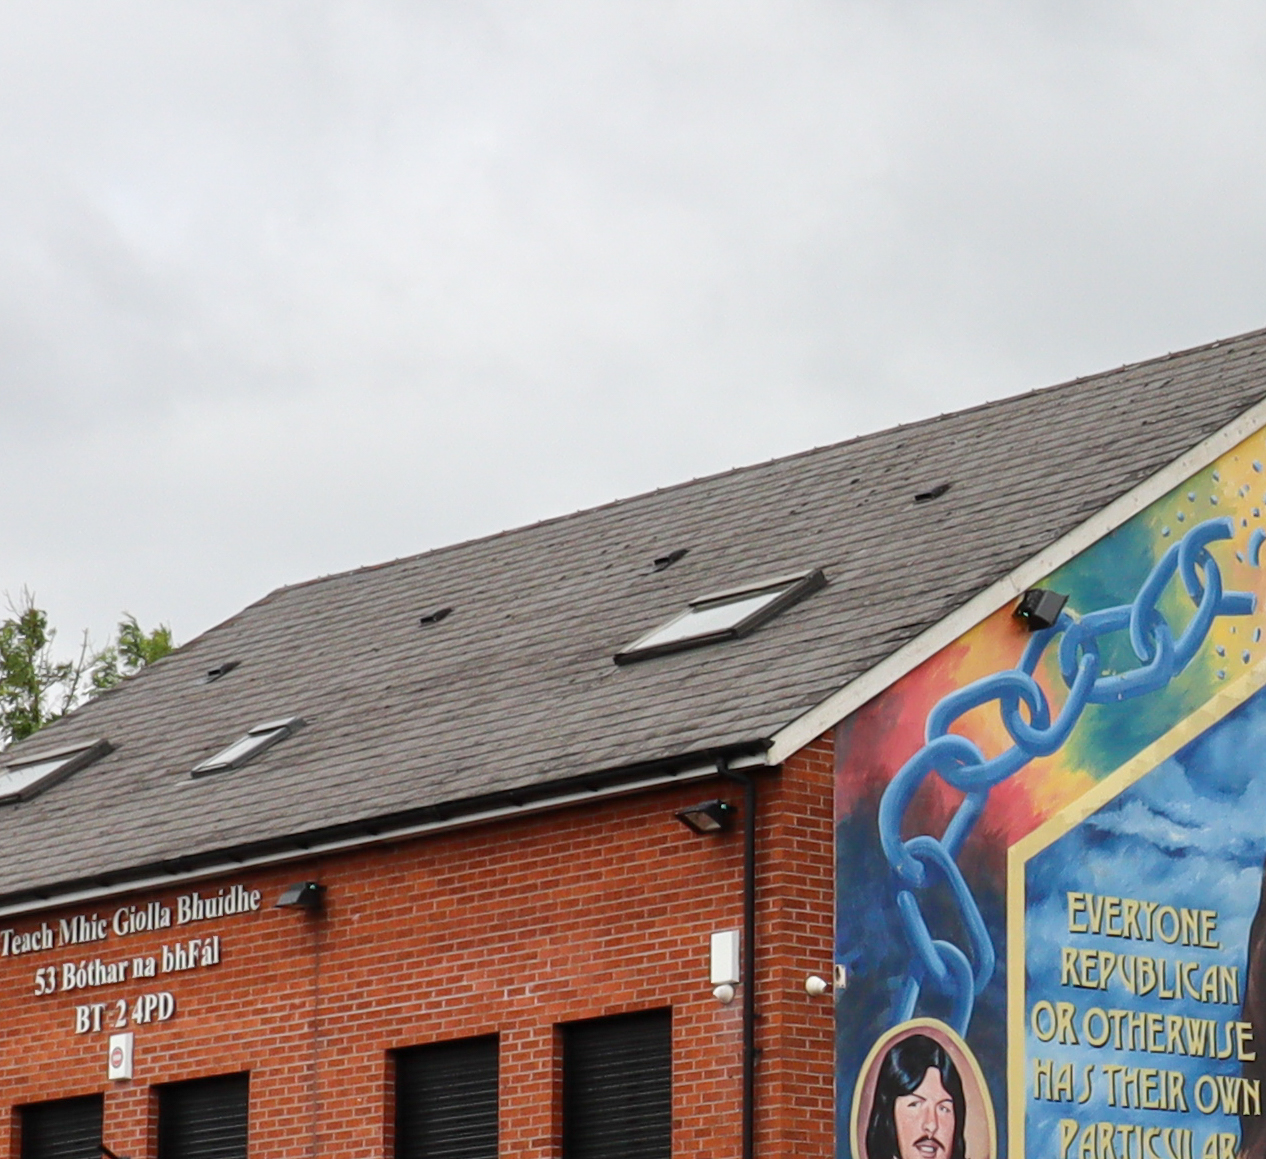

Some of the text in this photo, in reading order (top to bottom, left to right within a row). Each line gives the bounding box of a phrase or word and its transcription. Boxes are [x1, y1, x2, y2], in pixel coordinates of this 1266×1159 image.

[0, 884, 261, 957] Teach Mhic Giolla Bhuidhe
[34, 936, 221, 996] 53 Bóthar na bhFál
[1060, 946, 1241, 1005] REPUBLICAN
[75, 991, 175, 1035] BT 2 4PD
[1031, 1000, 1257, 1061] OR OTHERWISE
[1033, 1057, 1262, 1116] HAS THEIR OWN
